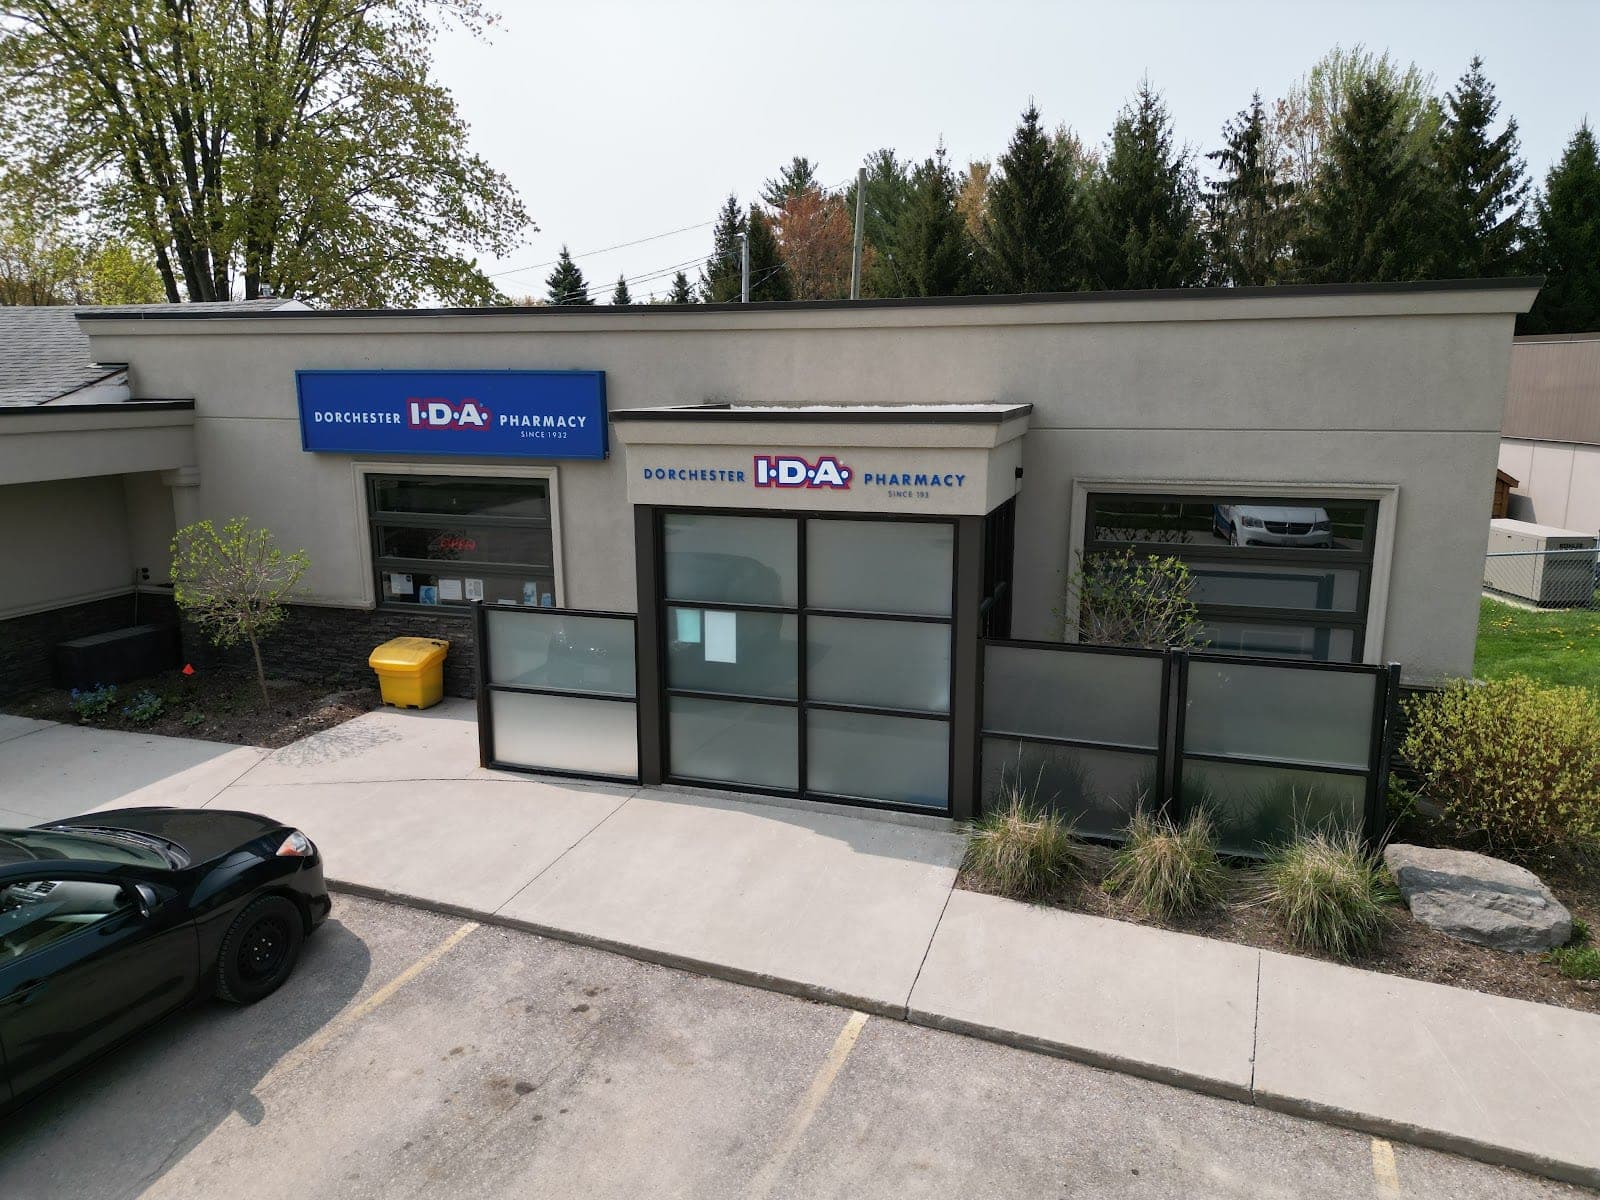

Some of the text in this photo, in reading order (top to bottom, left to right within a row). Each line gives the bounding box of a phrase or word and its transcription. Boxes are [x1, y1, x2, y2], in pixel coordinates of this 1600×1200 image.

[315, 411, 401, 424] DORCHESTER
[499, 414, 586, 428] PHARMACY
[520, 430, 568, 439] SINCE 1932
[643, 468, 745, 482] DORCHESTER
[864, 473, 965, 487] PHARMACY
[887, 490, 913, 498] SINCE
